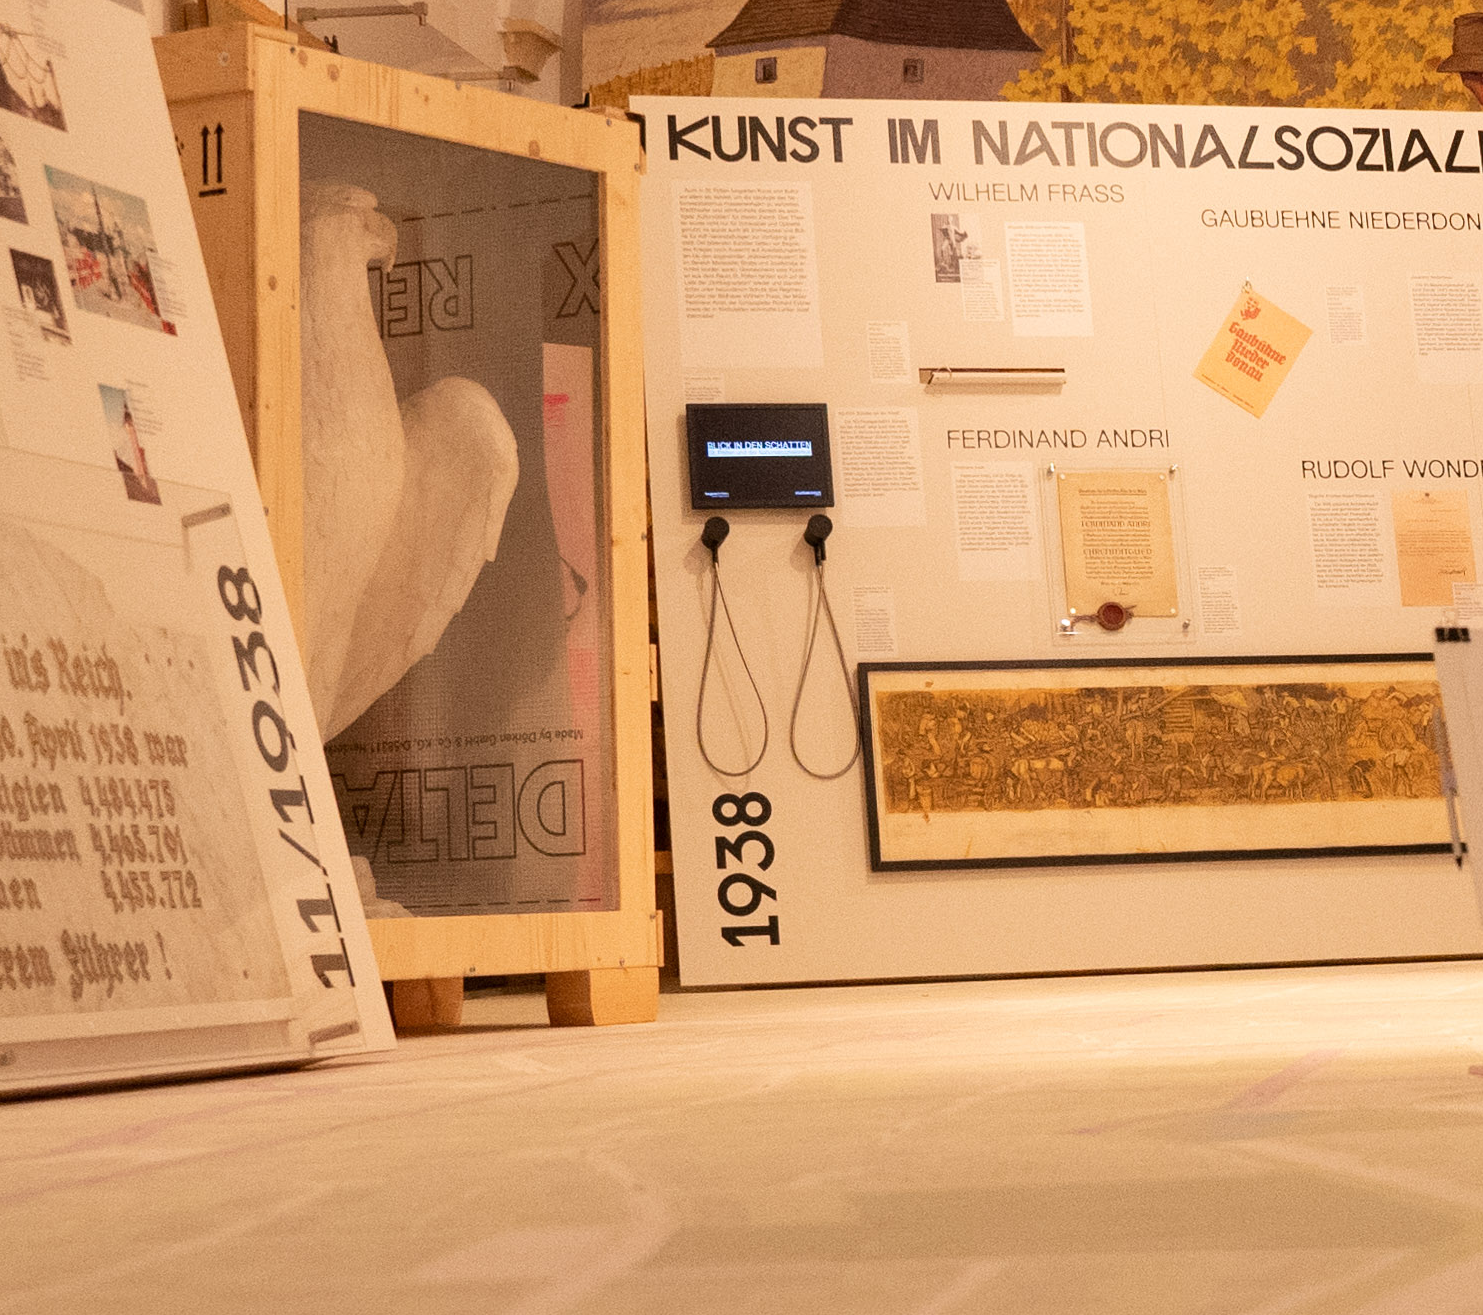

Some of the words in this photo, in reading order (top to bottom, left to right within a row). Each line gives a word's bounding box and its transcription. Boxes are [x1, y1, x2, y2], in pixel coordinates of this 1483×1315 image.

[667, 114, 854, 164] KUNST
[887, 118, 942, 165] IM
[928, 182, 1040, 203] WILHELM
[1048, 183, 1126, 204] FRASS
[1201, 208, 1341, 230] GAUBUEHNE
[1229, 321, 1286, 365] Gaubühne
[1231, 338, 1269, 369] Nieder
[708, 441, 732, 450] BLICK
[734, 441, 743, 449] IN
[744, 441, 763, 449] DEN
[764, 441, 811, 449] SCHATTEN
[947, 429, 1088, 450] FERDINAND
[1096, 429, 1171, 449] ANDRI
[1301, 459, 1396, 480] RUDOLF
[23, 711, 87, 771] April
[217, 564, 356, 990] 11/1938
[330, 758, 587, 864] DELTA
[712, 792, 780, 947] 1938
